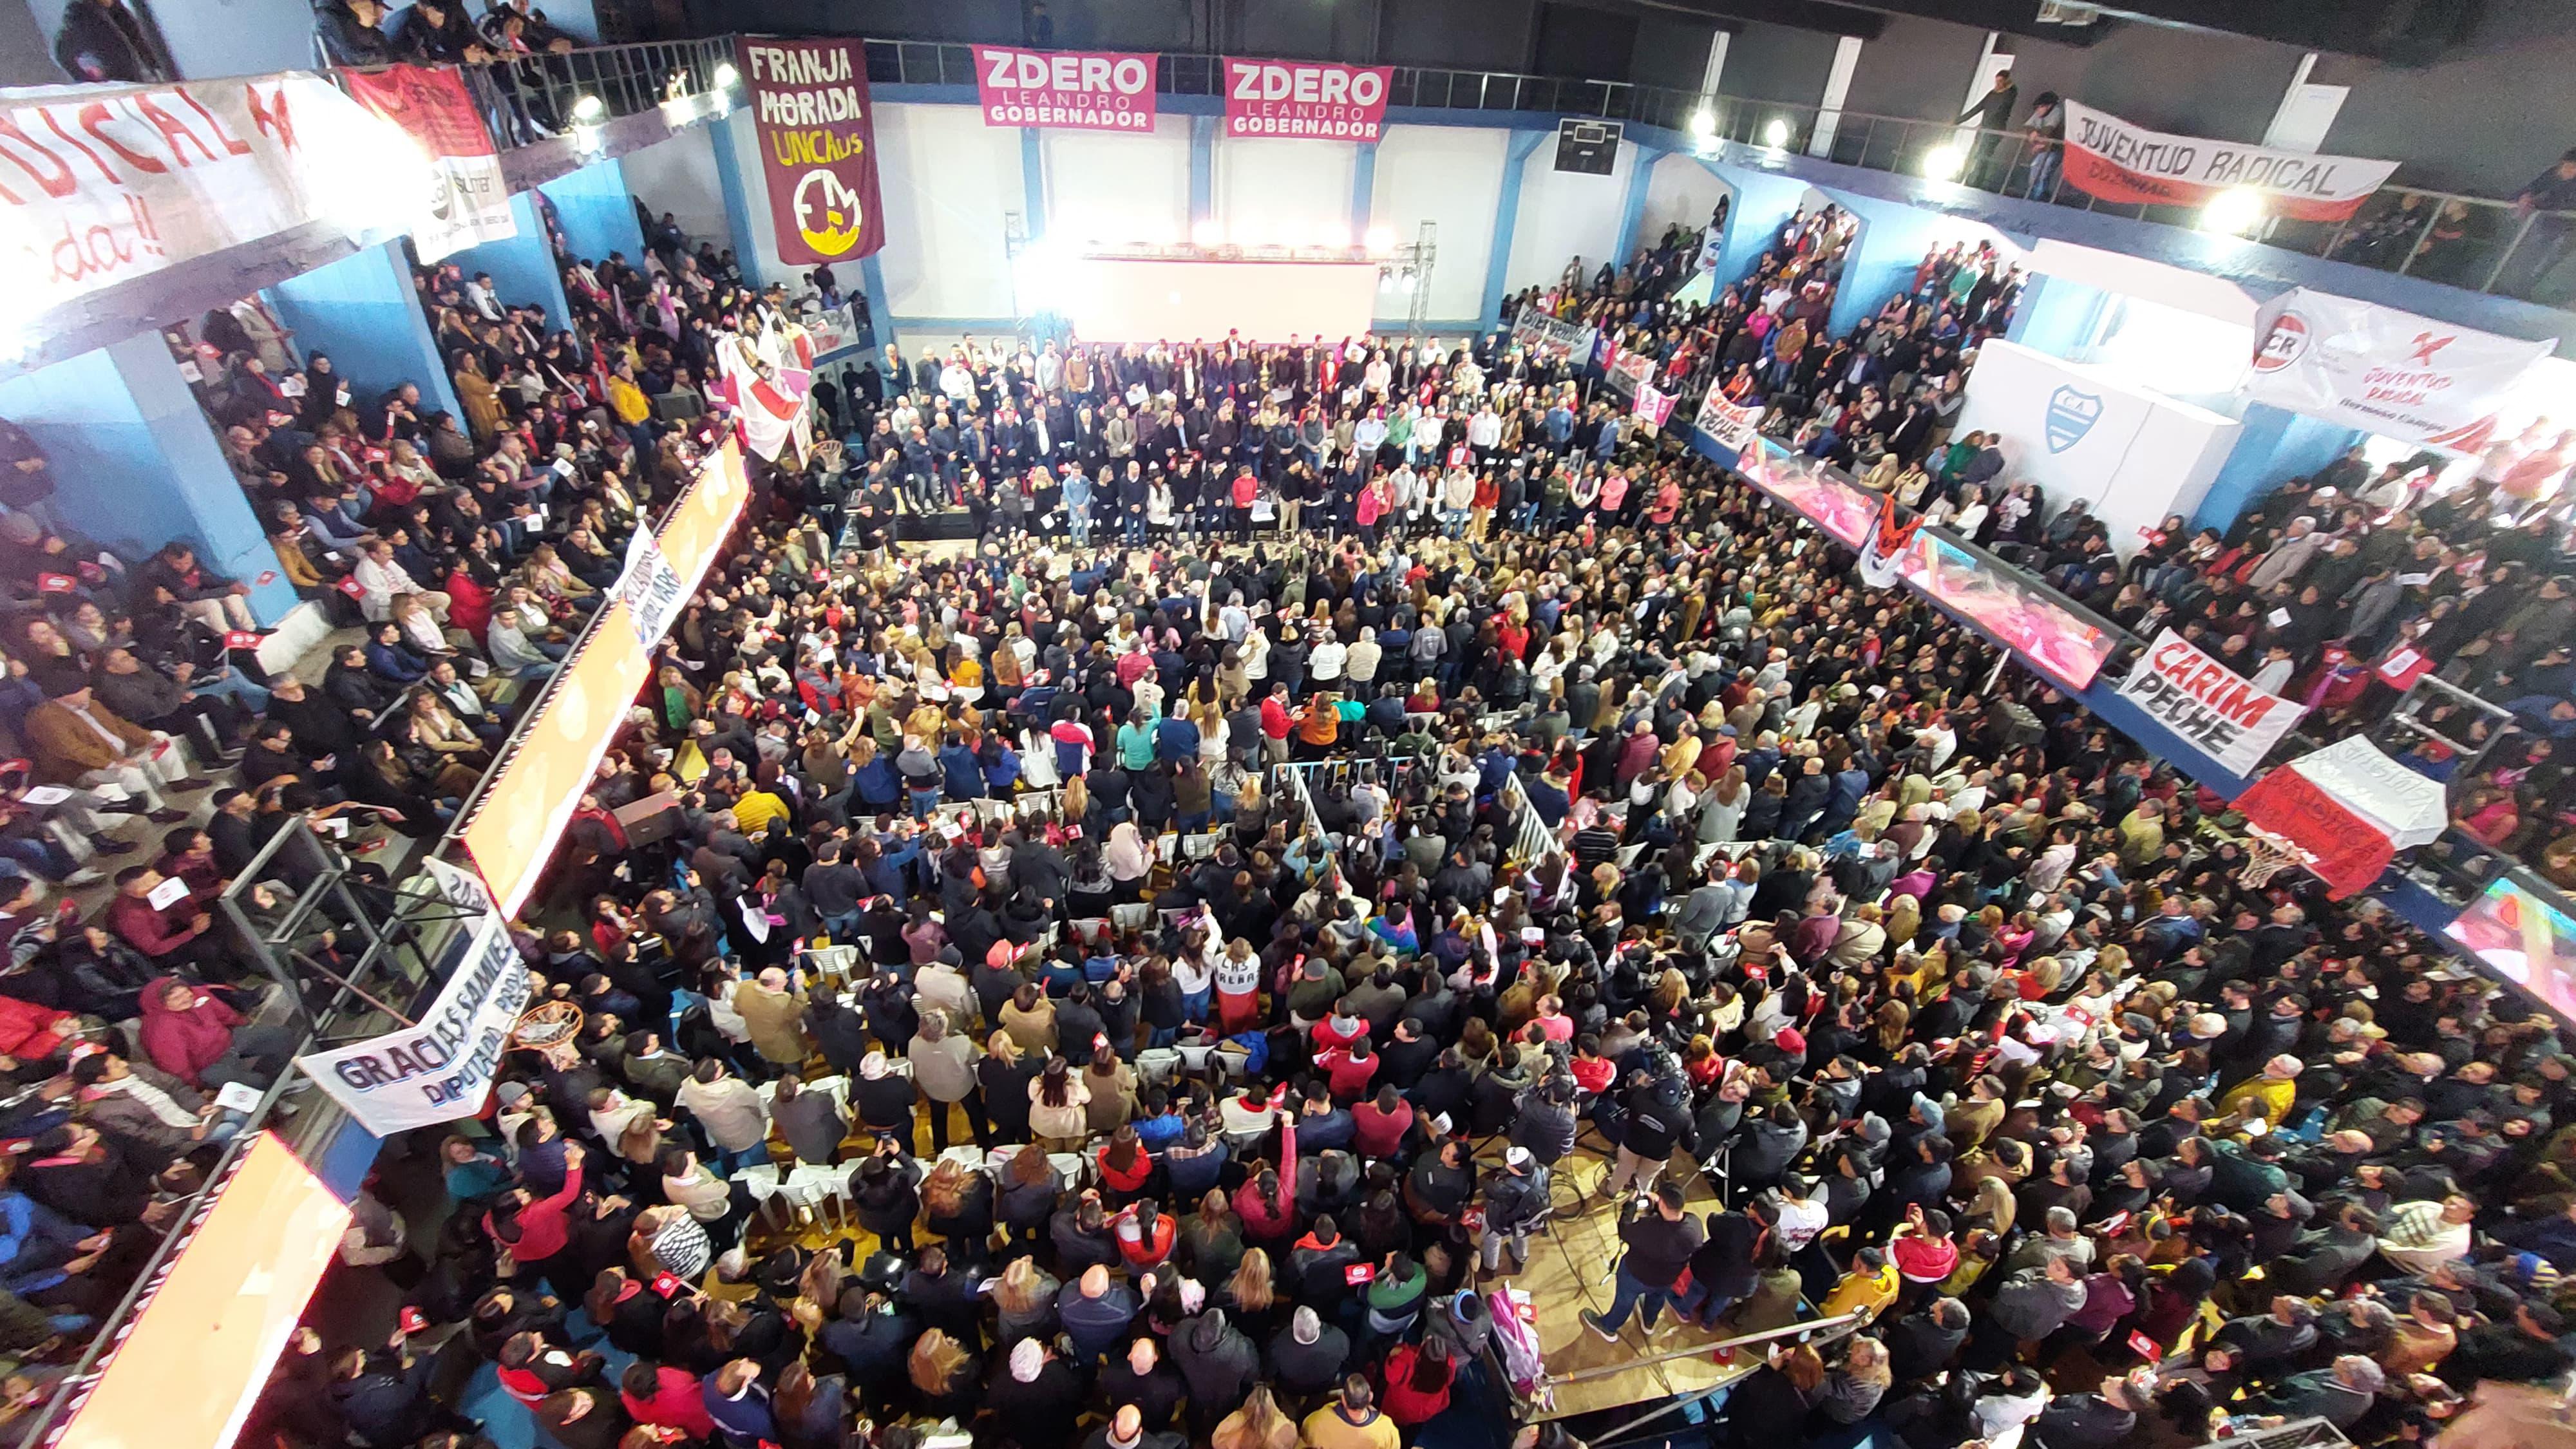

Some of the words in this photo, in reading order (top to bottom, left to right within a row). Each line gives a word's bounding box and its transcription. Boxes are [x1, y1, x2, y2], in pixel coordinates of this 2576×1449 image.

[748, 46, 853, 84] FRANJA
[983, 50, 1148, 95] ZDERO
[1232, 63, 1383, 106] ZDERO
[759, 86, 862, 126] MORADA
[990, 105, 1148, 128] GOBERNADOR
[1003, 90, 1130, 110] LEANDRO
[1247, 102, 1364, 121] LEANDRO
[0, 86, 253, 205] DICAL
[1234, 117, 1378, 138] GOBERNADOR
[2077, 117, 2197, 175] JUVENTUD
[2202, 150, 2338, 196] RADICAL
[2154, 641, 2278, 729] CARIM
[2129, 670, 2246, 755] PECHE
[335, 1005, 469, 1092] GRACIAS
